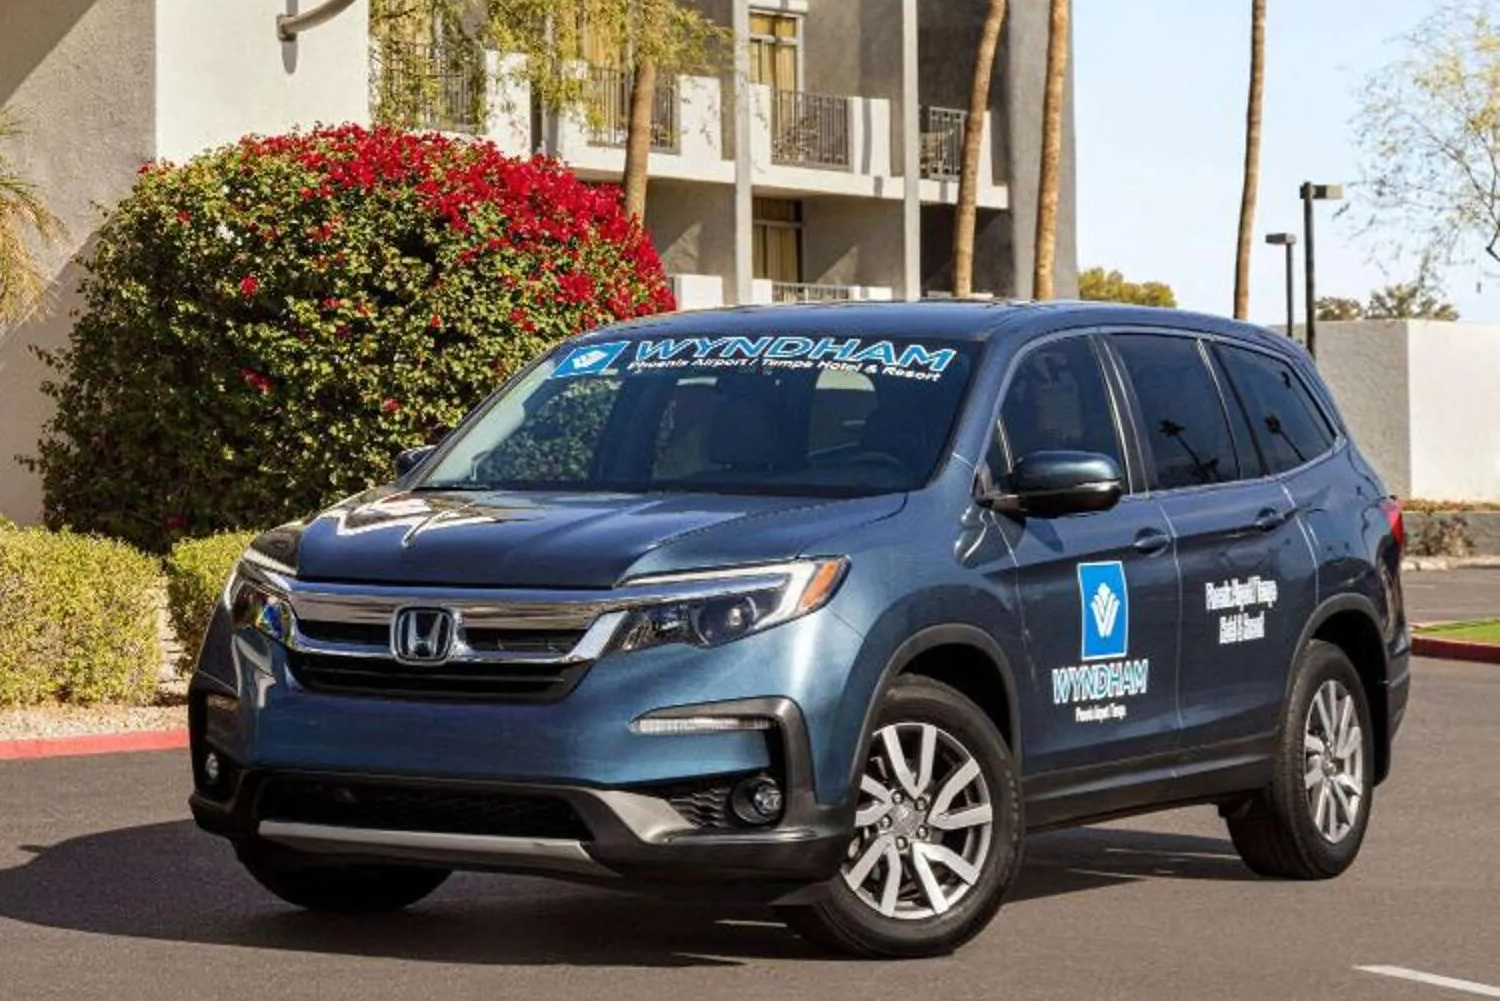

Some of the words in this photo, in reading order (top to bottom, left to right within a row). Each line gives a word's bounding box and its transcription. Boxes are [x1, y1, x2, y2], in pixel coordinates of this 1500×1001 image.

[636, 336, 956, 372] WYNDHAM
[691, 359, 748, 369] Airport
[762, 359, 813, 370] Tempe
[817, 360, 862, 372] Hotel
[881, 367, 941, 382] Resort
[1052, 659, 1148, 704] WYNDHAM
